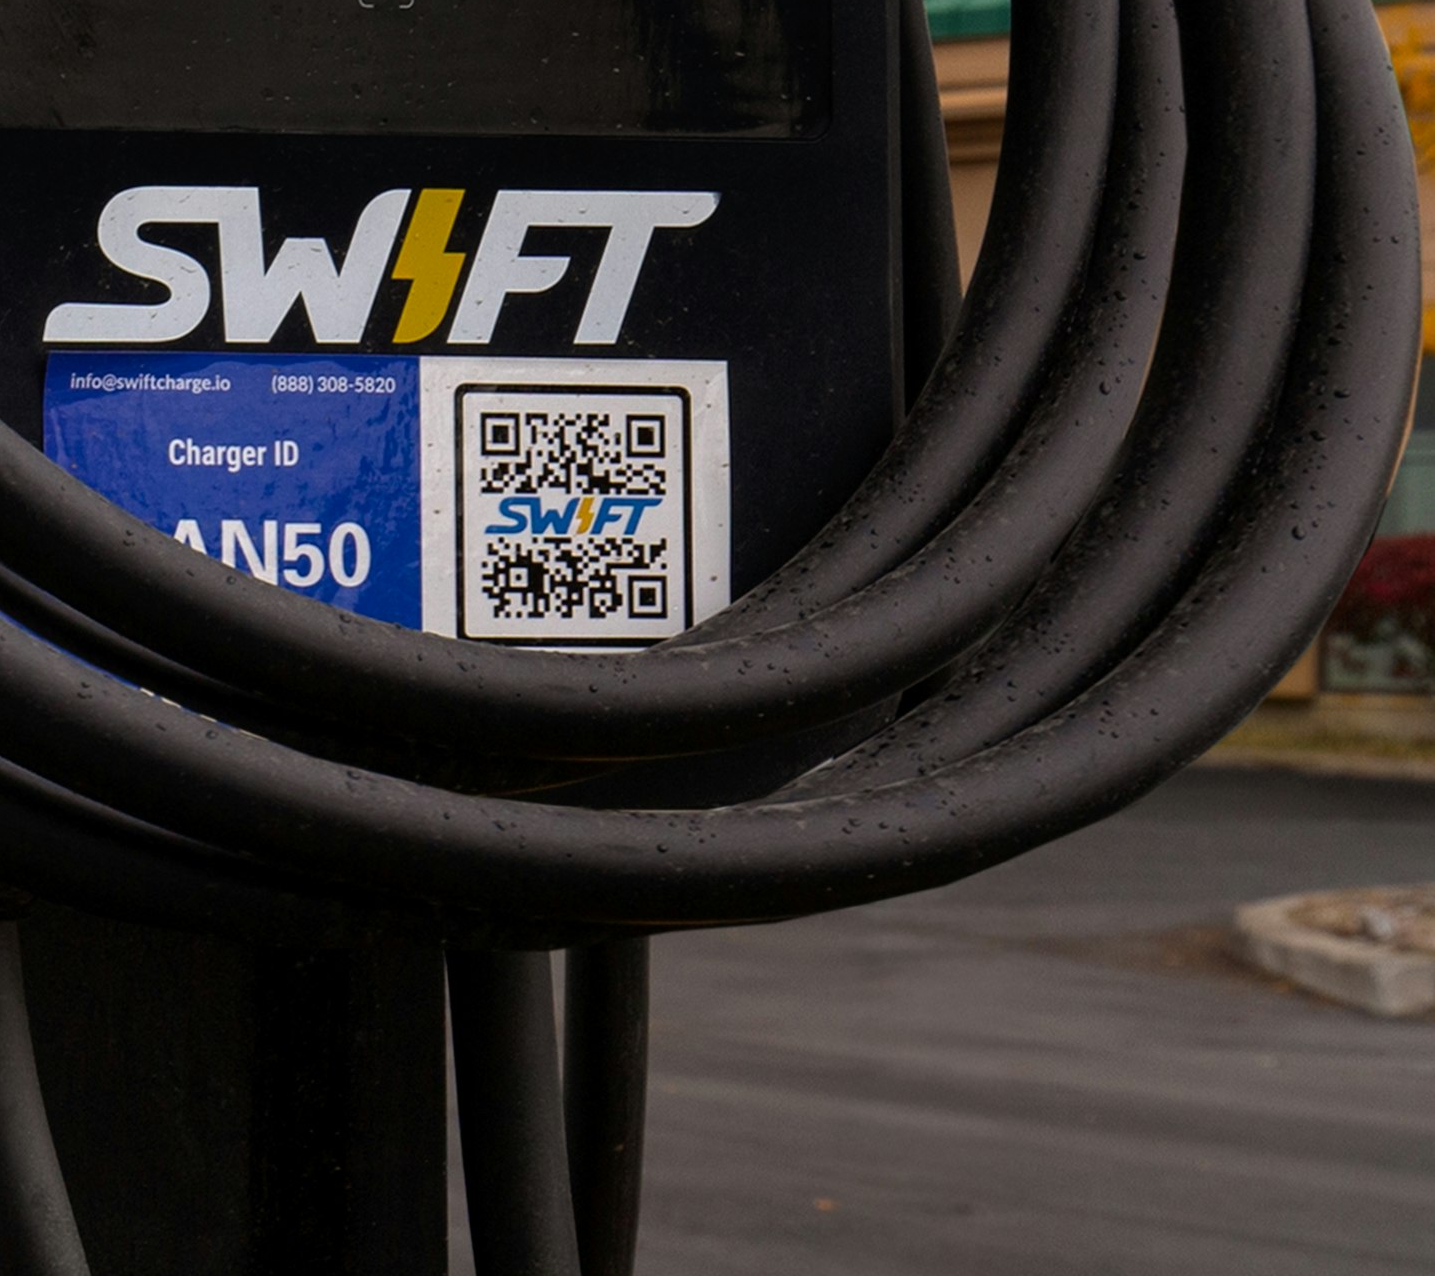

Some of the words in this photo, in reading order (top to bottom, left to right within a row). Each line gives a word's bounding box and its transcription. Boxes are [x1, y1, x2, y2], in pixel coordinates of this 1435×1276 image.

[42, 185, 722, 344] SWIFT
[70, 372, 232, 395] info@swiftcharge.io
[271, 374, 314, 395] (888)
[317, 375, 396, 394] 308-5820
[168, 438, 267, 473] Charger
[274, 440, 300, 467] ID
[484, 496, 664, 536] SWIFT
